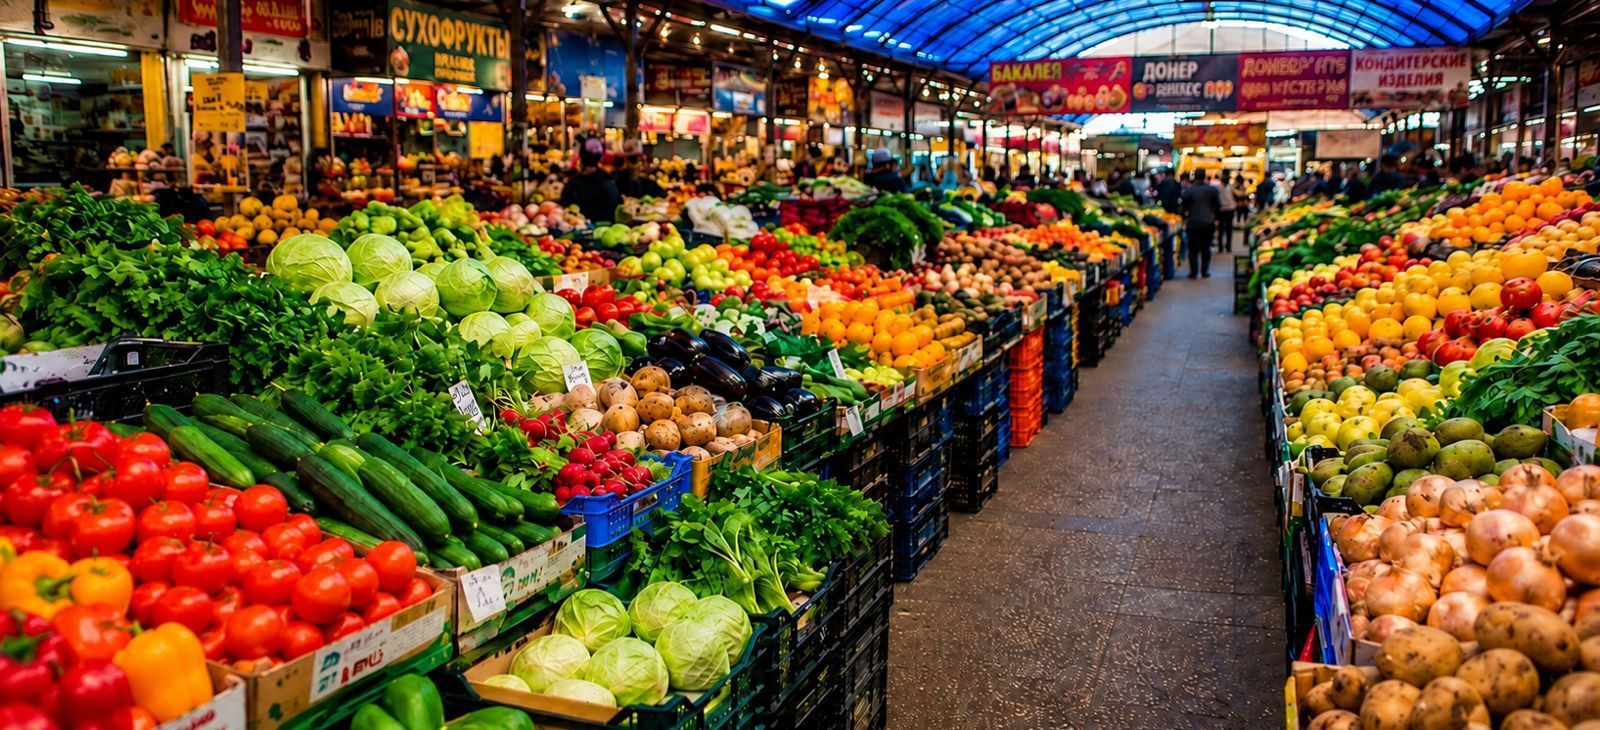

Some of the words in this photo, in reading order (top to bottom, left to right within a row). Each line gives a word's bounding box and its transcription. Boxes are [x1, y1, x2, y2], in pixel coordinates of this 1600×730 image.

[391, 6, 511, 59] СУХОФРУКТЫ
[992, 62, 1062, 82] БАКАЛЕЯ
[1143, 61, 1198, 83] ДОНЕР
[1356, 53, 1467, 72] КОНДИТЕРСКИЕ
[1378, 72, 1444, 88] ИЗДЕЛИЯ
